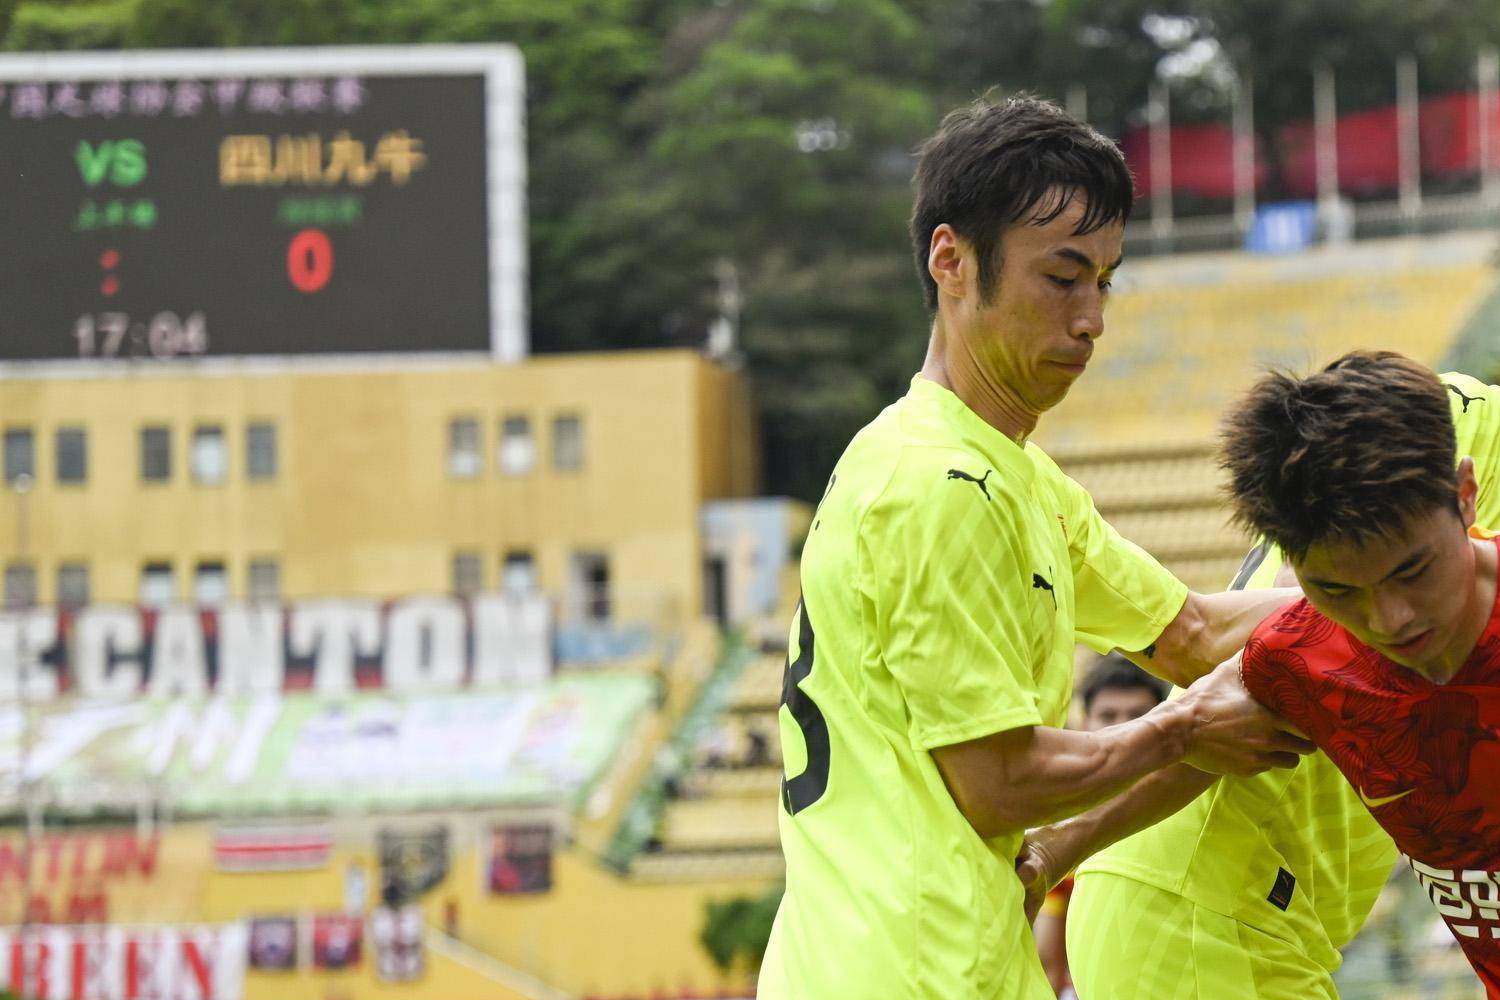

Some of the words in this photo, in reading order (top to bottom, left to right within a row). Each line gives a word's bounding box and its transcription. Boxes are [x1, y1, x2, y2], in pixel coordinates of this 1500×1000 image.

[74, 138, 148, 187] VS
[219, 131, 426, 187] 四川九牛
[287, 228, 334, 293] 0
[74, 596, 556, 692] CANTON
